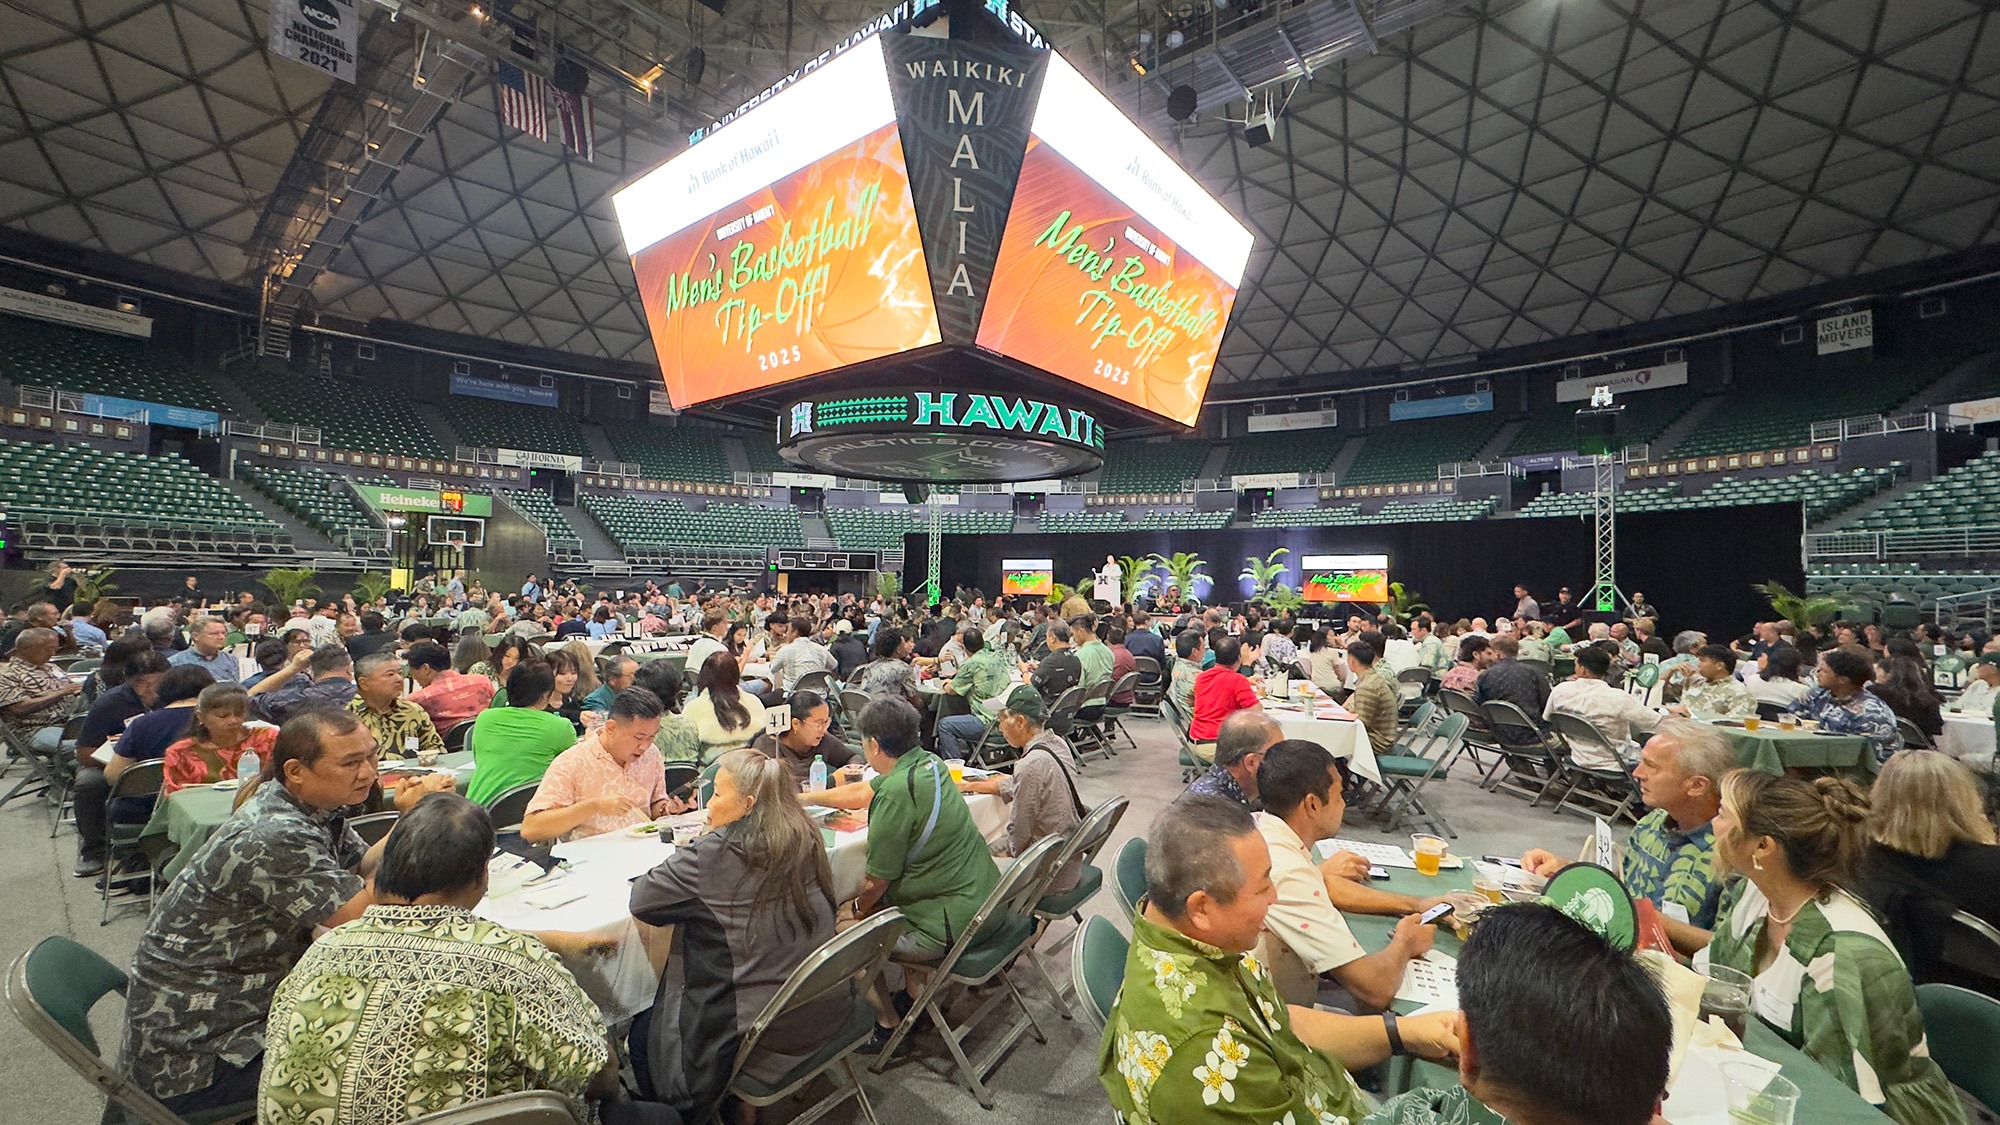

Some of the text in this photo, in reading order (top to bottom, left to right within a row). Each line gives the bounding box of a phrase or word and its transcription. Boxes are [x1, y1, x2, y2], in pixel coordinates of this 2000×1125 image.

[302, 5, 340, 28] NCAA
[284, 28, 353, 64] CHAMPIONS
[293, 20, 346, 51] NATIONAL
[300, 47, 338, 73] 2021
[905, 60, 1026, 88] WAIKIKI
[701, 162, 728, 185] Bank
[947, 89, 985, 298] MALIA
[666, 178, 882, 320] Men's Basketball
[1033, 210, 1219, 341] Men's Basketball
[715, 263, 830, 354] Tip-Off!
[1075, 289, 1177, 370] Tip-Off!
[1819, 325, 1872, 345] MOVERS
[1821, 314, 1868, 333] ISLAND
[758, 345, 802, 371] 2025
[1093, 359, 1131, 385] 2025
[515, 451, 566, 464] CALIFORNIA
[1529, 456, 1554, 464] ALTRES
[769, 712, 785, 728] 41
